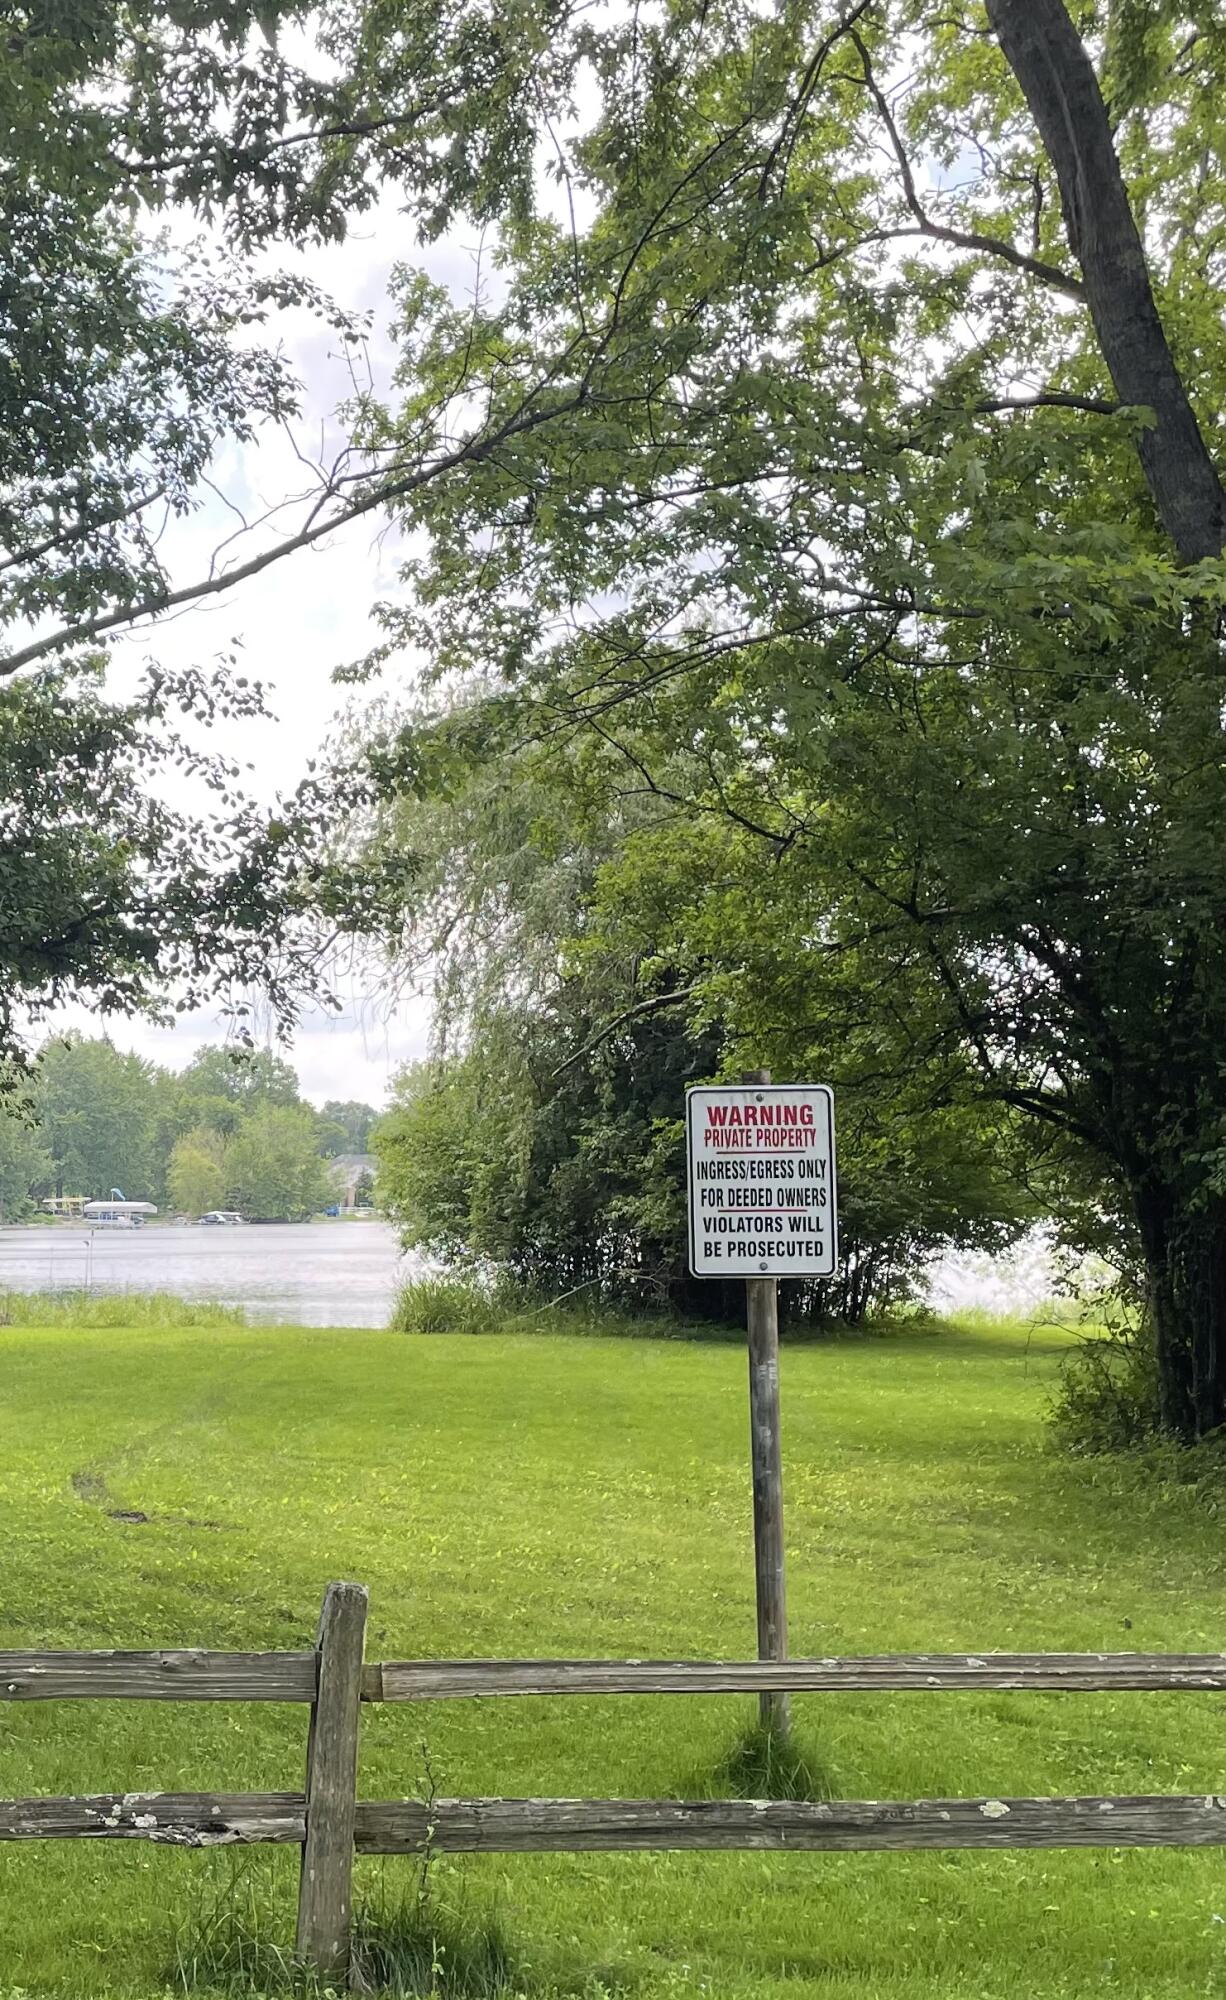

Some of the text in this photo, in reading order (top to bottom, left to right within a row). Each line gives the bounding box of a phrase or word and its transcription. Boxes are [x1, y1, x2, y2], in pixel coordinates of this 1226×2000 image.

[707, 1105, 814, 1126] WARNING
[704, 1128, 816, 1148] PRIVATE PROPERTY
[697, 1159, 826, 1181] INGRESS/EGRESS ONLY
[701, 1187, 827, 1207] FOR DEEDED OWNERS
[703, 1216, 824, 1233] VIOLATORS WILL
[704, 1240, 823, 1258] BE PROSECUTED
